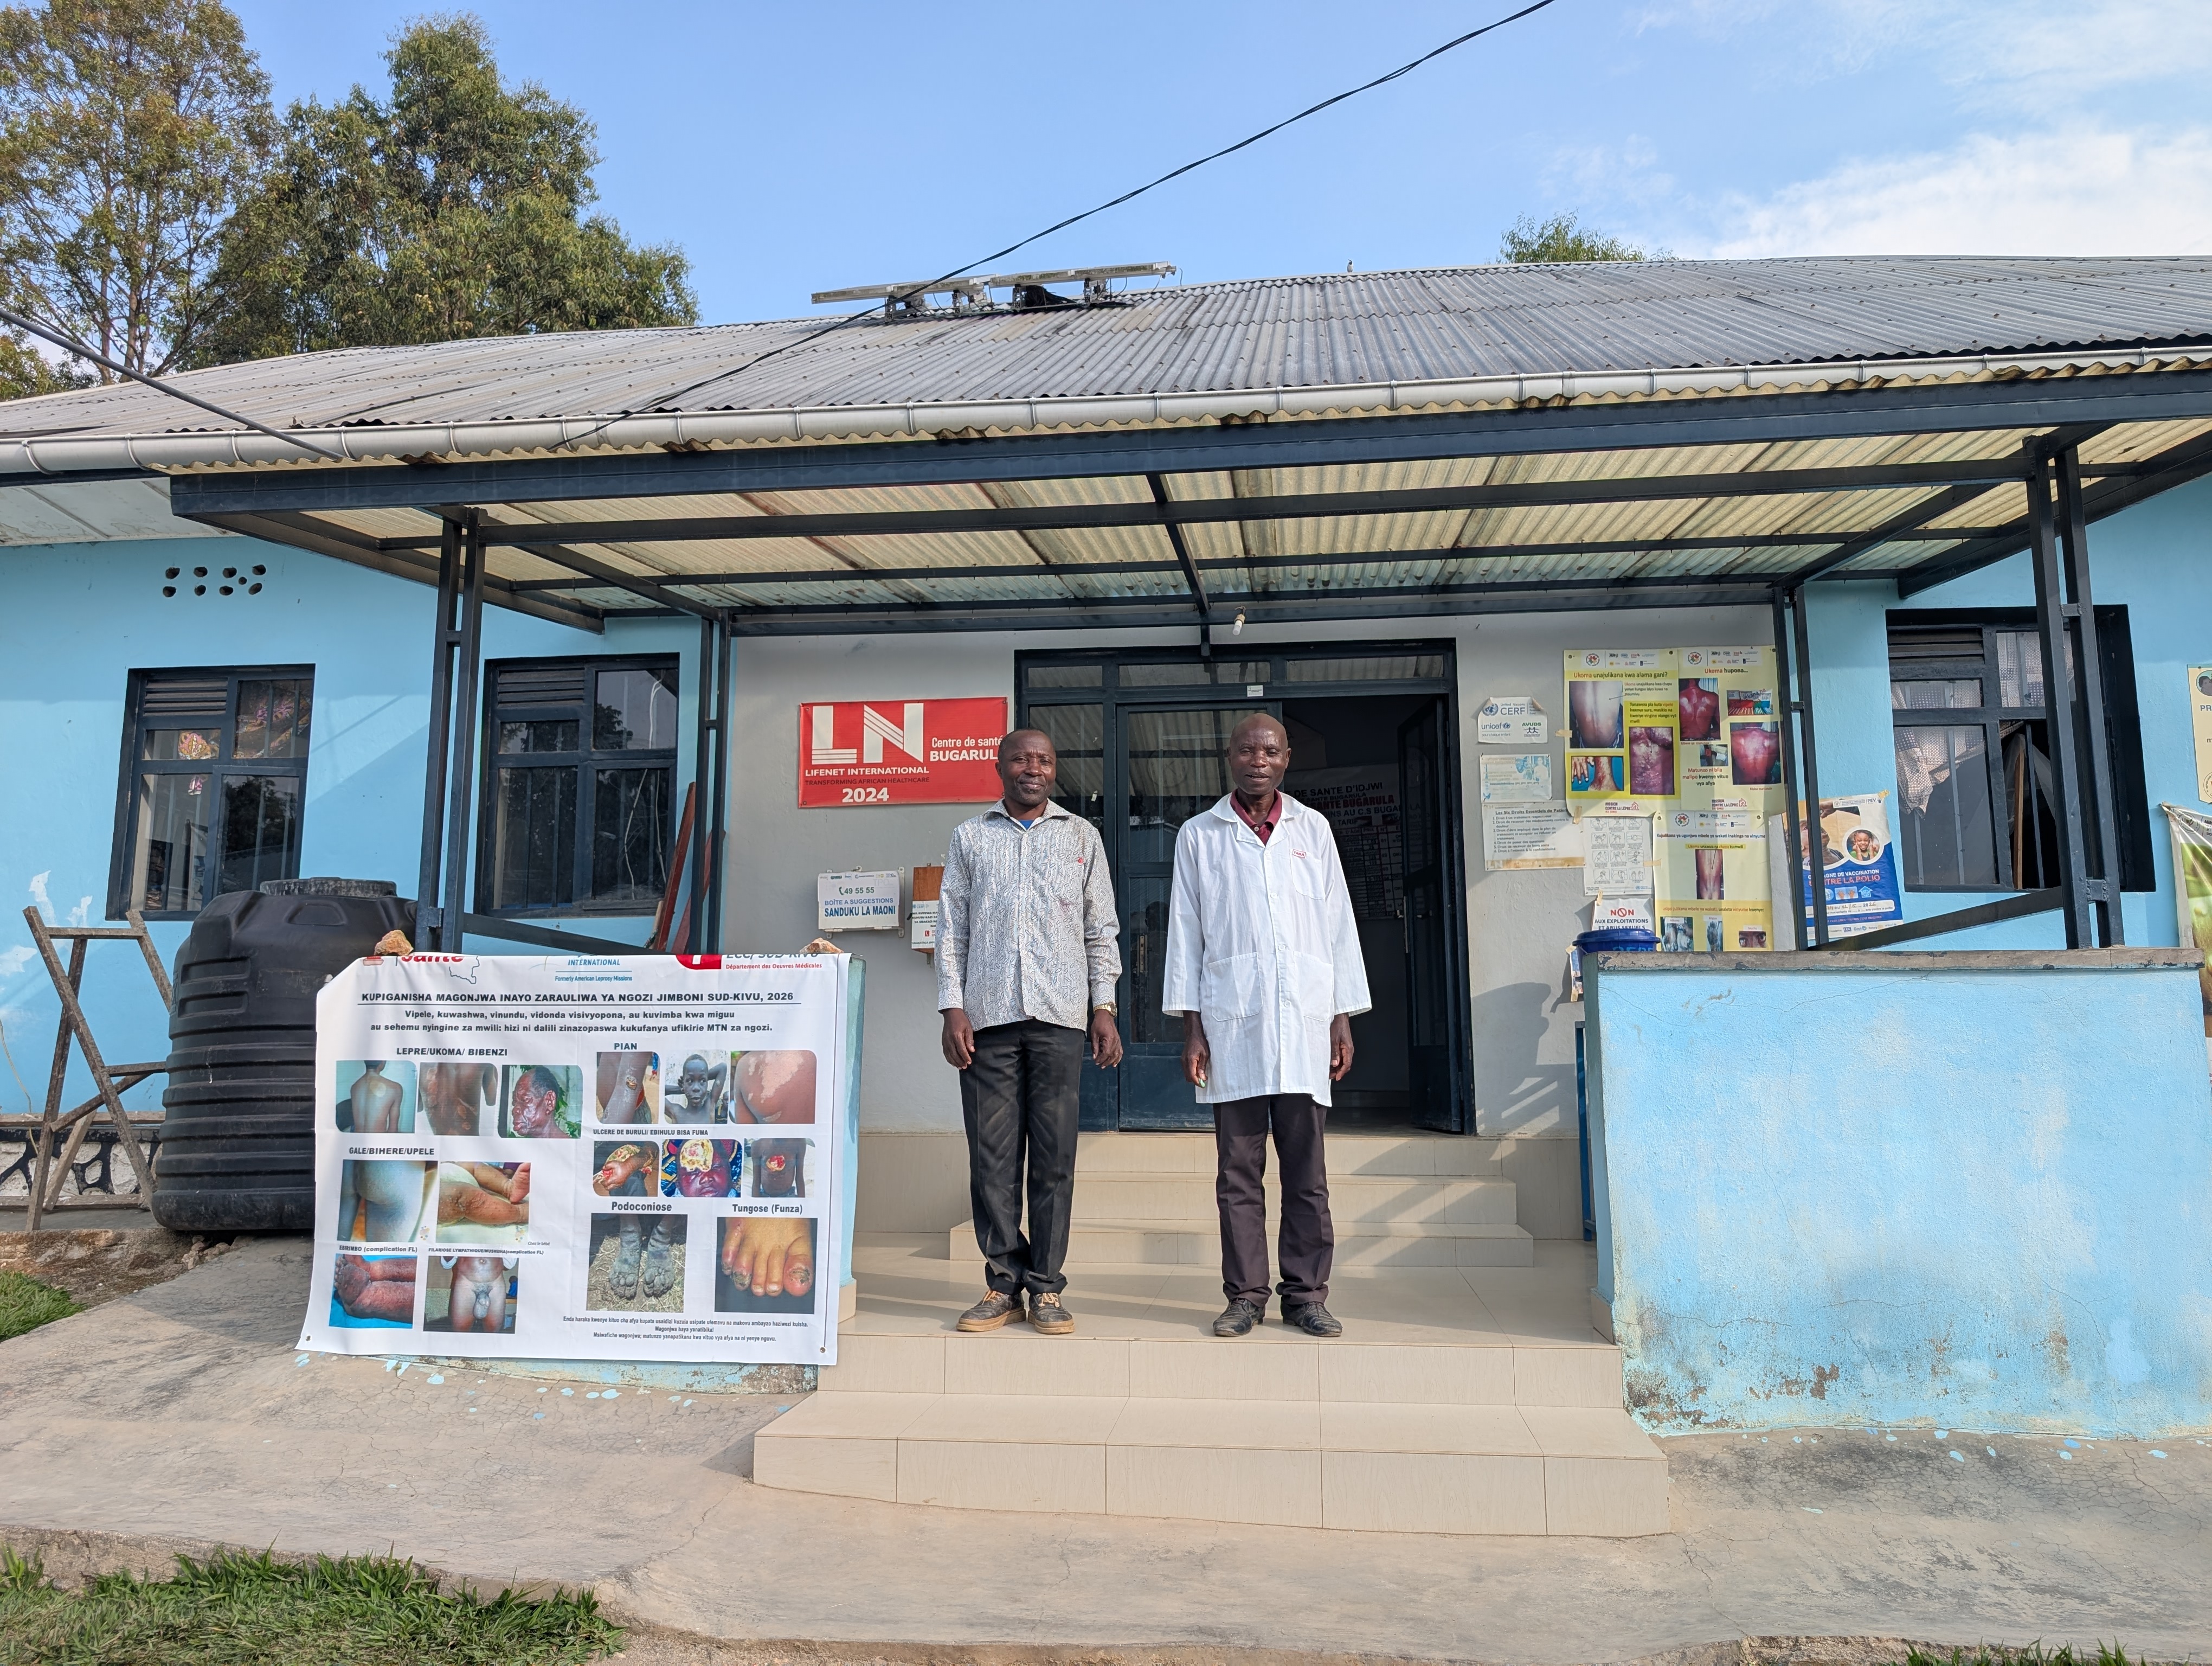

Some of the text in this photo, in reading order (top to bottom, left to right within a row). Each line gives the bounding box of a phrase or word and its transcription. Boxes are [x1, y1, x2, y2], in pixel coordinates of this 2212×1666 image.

[931, 736, 961, 748] Centre
[964, 736, 975, 747] de
[805, 766, 929, 776] LIFENET INTERNATIONAL
[842, 787, 889, 803] 2024
[1294, 790, 1307, 798] DE
[1310, 786, 1342, 796] SANTE
[1343, 794, 1394, 808] BUGARULA
[824, 905, 895, 917] SANDUKU LA MAONI
[362, 993, 432, 1002] KUPIGANISHA
[436, 994, 496, 1002] MAGONJWA
[500, 994, 531, 1002] INAYO
[535, 994, 597, 1002] ZARAULIWA
[601, 994, 615, 1002] YA
[657, 993, 703, 1001] JIMBONI
[708, 992, 763, 1002] SUD-KIVU,
[404, 1010, 434, 1019] Vipele,
[437, 1010, 487, 1020] kuwashwa,
[490, 1011, 527, 1020] vinundu,
[568, 1011, 625, 1020] visivyopona,
[707, 1010, 734, 1019] miguu
[422, 1023, 459, 1032] nyingine
[559, 1024, 617, 1033] zinazopaswa
[620, 1024, 668, 1033] kukufanya
[744, 1023, 772, 1033] ngozi.
[396, 1047, 465, 1055] LEPRE/UKOMA/
[612, 1202, 672, 1211] Podoconiose
[732, 1203, 802, 1215] Tungose (Funza)
